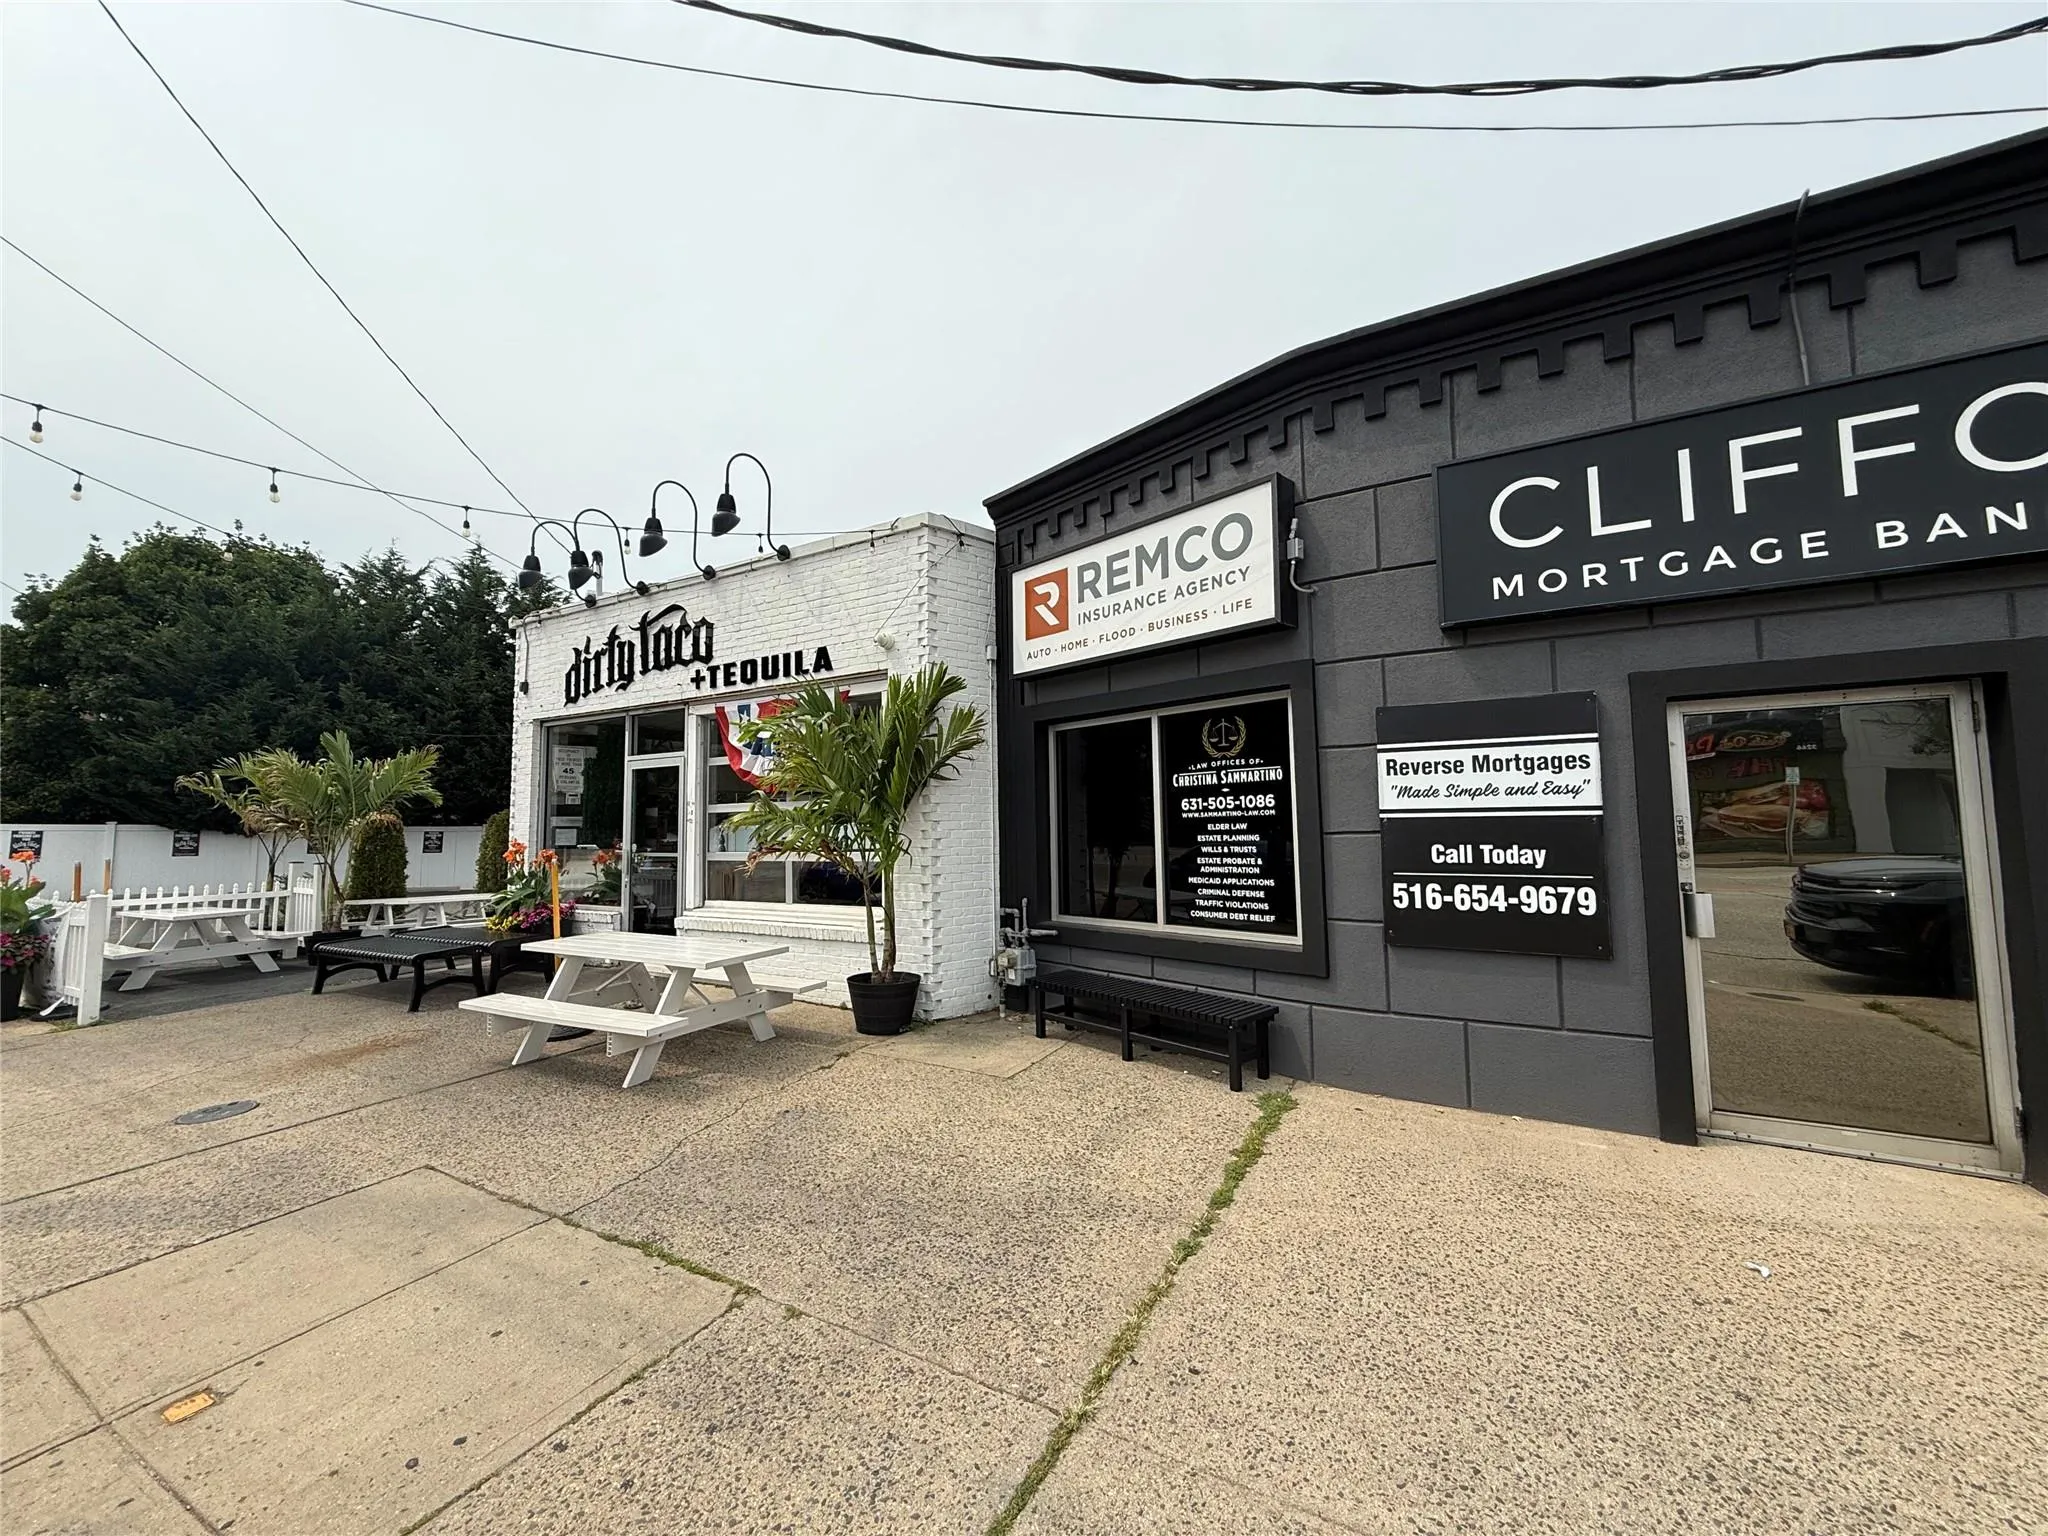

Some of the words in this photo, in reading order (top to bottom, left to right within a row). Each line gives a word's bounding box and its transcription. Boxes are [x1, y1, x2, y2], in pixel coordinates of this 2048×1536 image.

[1077, 512, 1253, 604] REMCO
[1492, 530, 1829, 600] MORTGAGE
[1876, 502, 2029, 549] BAN
[1077, 589, 1167, 626] INSURANCE
[1174, 566, 1252, 600] AGENCY
[1026, 647, 1051, 661] AUTO
[1060, 637, 1089, 653] HOME
[1099, 626, 1136, 645] FLOOD
[1147, 608, 1208, 633] BUSINESS
[1222, 597, 1253, 616] LIFE
[563, 625, 637, 707] dirty
[562, 767, 575, 775] 45
[1191, 762, 1208, 771] LAW
[1211, 758, 1246, 768] OFFICES
[1385, 758, 1465, 776] Reverse
[1472, 753, 1591, 776] Mortgages
[1172, 773, 1219, 787] CHRISTINA
[1220, 768, 1283, 784] SAMMARTINO
[1443, 782, 1501, 801] Simple
[1504, 782, 1540, 797] and
[1181, 794, 1276, 811] 631-505-1086
[1182, 809, 1276, 819] WWW.SAMMARTINO-LAW.COM
[1207, 823, 1230, 831] ELDER
[1231, 822, 1248, 830] LAW
[1197, 857, 1221, 865] ESTATE
[1222, 857, 1256, 865] PROBATE
[1430, 844, 1473, 865] Call
[1479, 844, 1547, 869] Today
[1200, 866, 1260, 874] ADMINISTRATION
[1188, 876, 1221, 884] MEDICAID
[1222, 878, 1275, 887] APPLICATIONS
[1197, 888, 1231, 897] CRIMINAL
[1232, 890, 1265, 898] DEFENSE
[1392, 882, 1597, 916] 516-654-9679
[1195, 899, 1224, 908] TRAFFIC
[1225, 901, 1269, 910] VIOLATIONS
[1190, 910, 1228, 919] CONSUMER
[1229, 912, 1249, 921] DEBT
[1249, 914, 1276, 923] RELIEF
